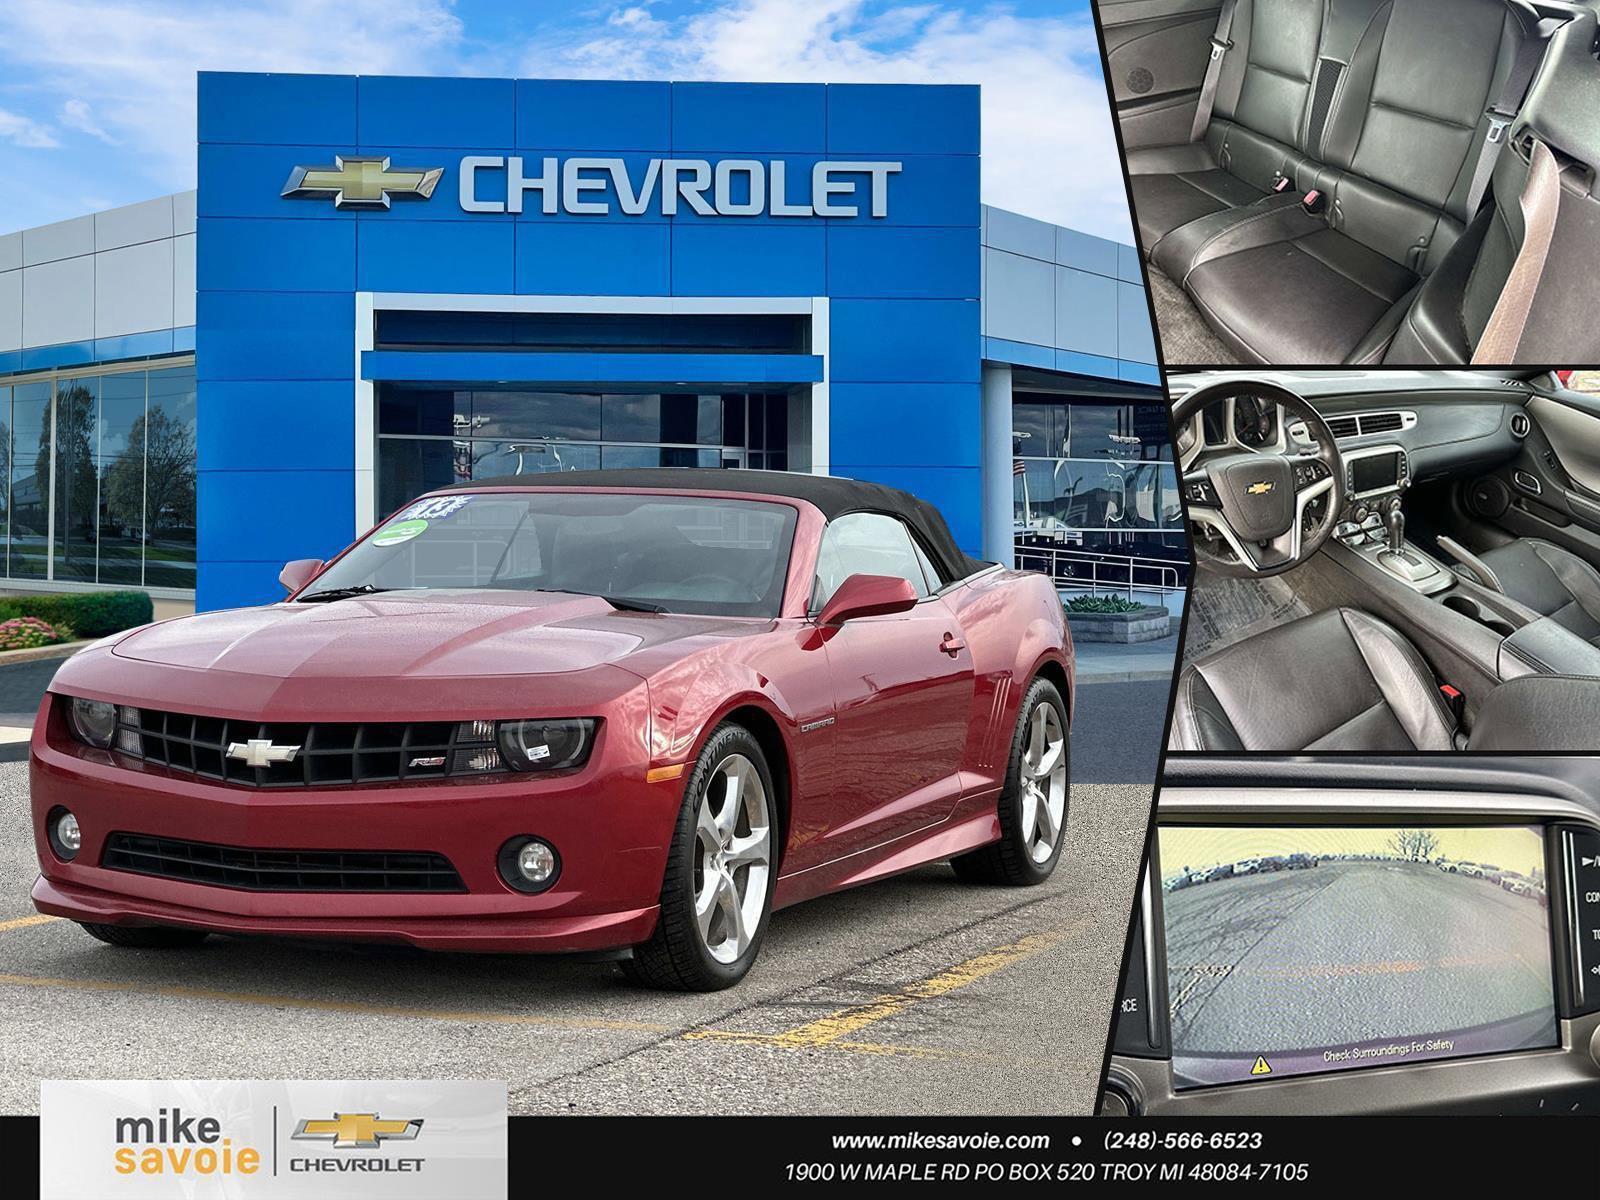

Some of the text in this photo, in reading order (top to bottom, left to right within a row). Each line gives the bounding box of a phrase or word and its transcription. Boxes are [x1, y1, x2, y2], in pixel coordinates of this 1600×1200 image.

[459, 155, 903, 218] CHEVROLET
[1323, 1039, 1454, 1062] Check Surroundings For Safety
